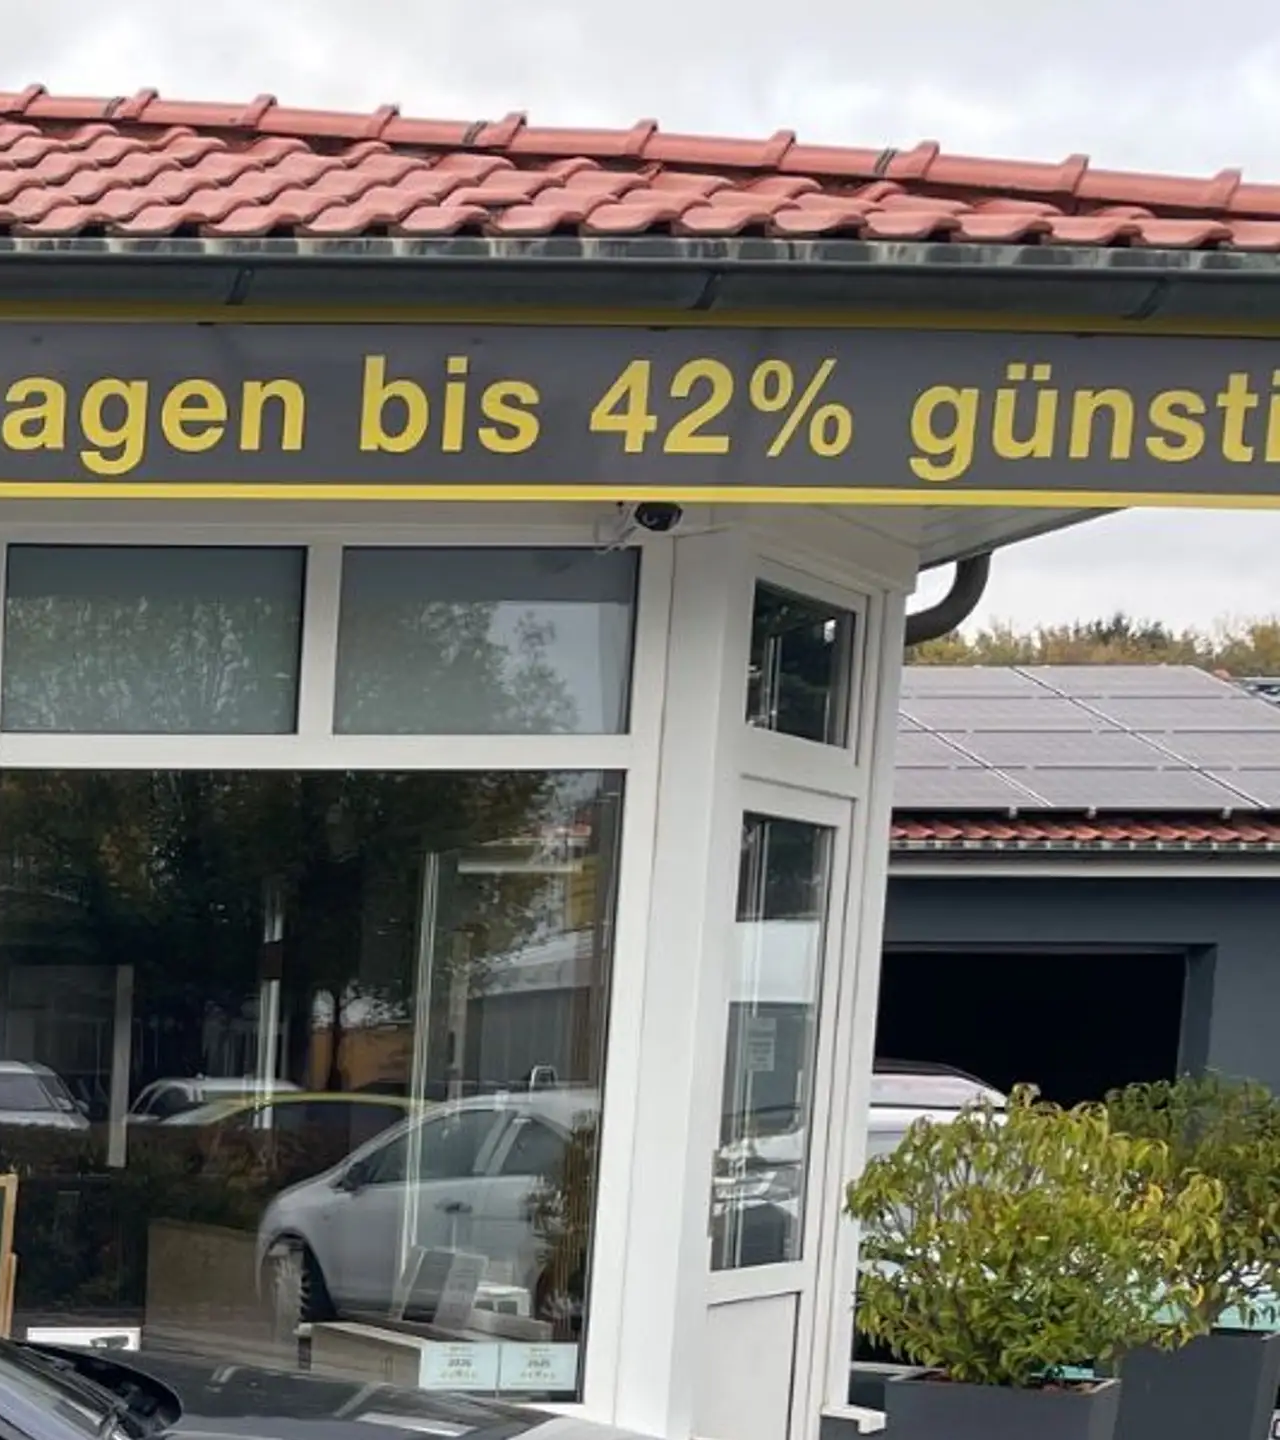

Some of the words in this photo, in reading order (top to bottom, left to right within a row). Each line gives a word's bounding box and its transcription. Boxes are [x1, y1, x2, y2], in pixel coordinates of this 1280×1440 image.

[359, 356, 540, 453] bis
[589, 358, 853, 457] 42%
[909, 363, 1280, 482] günsti
